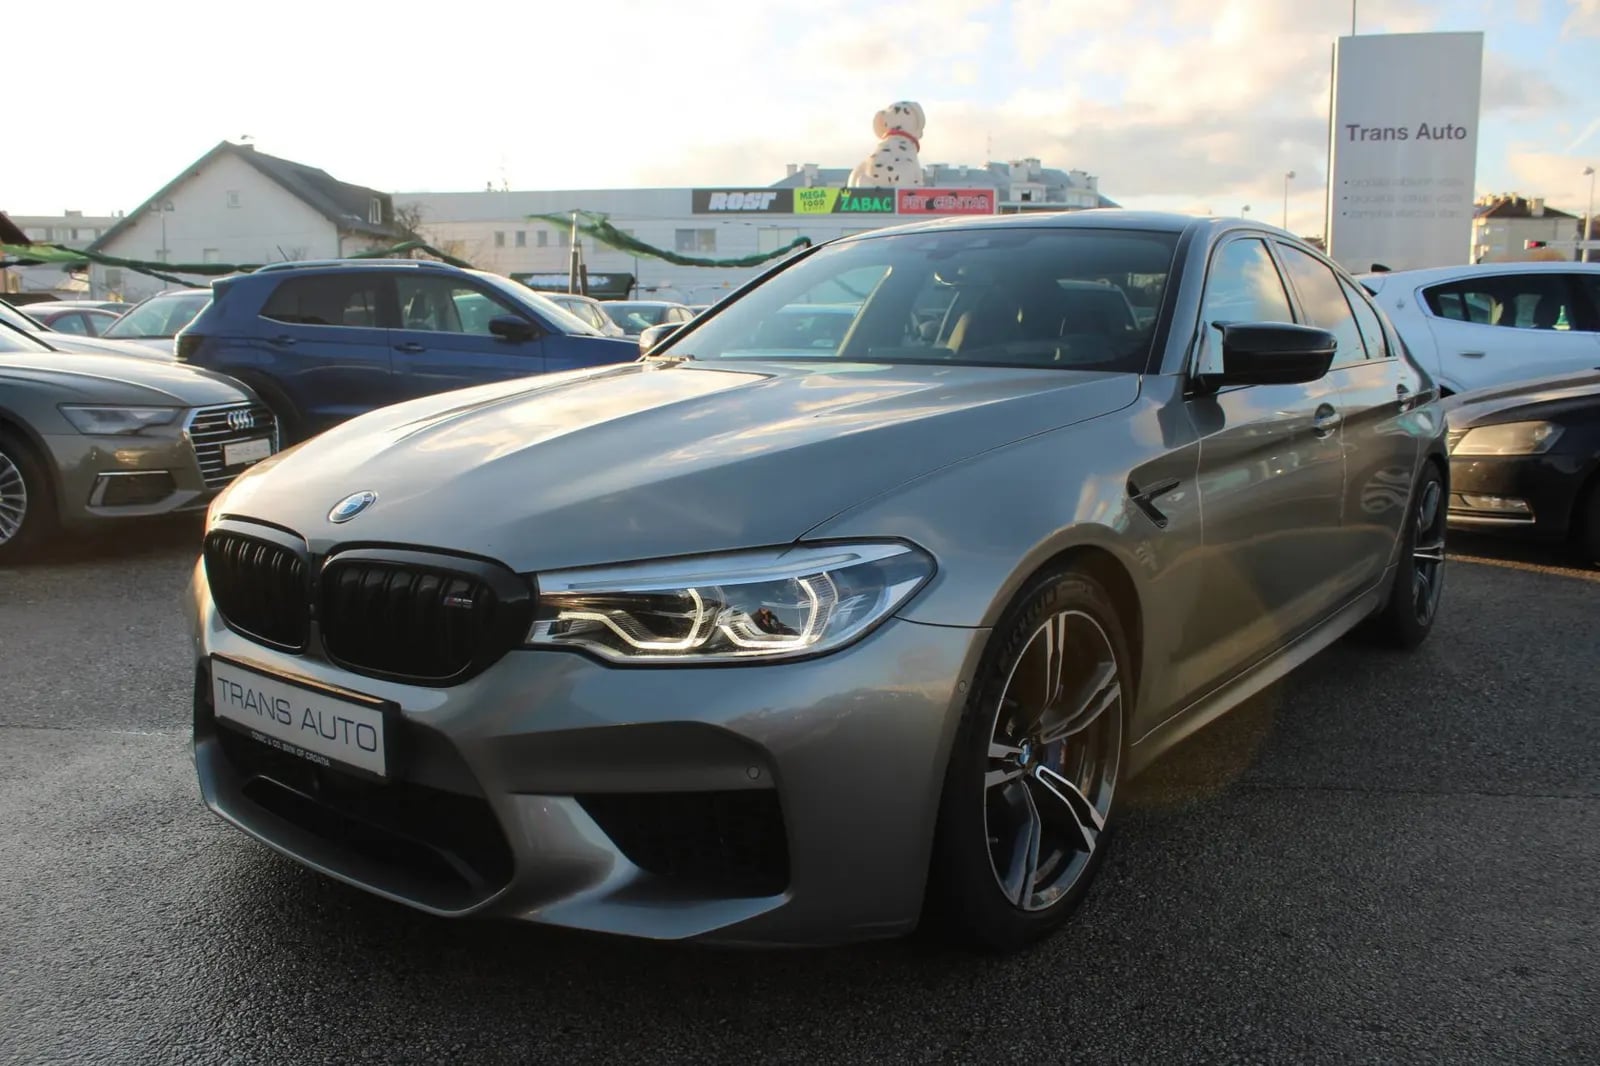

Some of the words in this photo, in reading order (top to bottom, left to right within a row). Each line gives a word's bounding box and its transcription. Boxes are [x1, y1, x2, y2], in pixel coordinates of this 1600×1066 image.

[1345, 124, 1408, 141] Trans
[1416, 122, 1467, 140] Auto
[709, 192, 777, 210] ROST
[800, 189, 827, 200] MEGA
[217, 677, 292, 726] TRANS
[301, 707, 378, 752] AUTO
